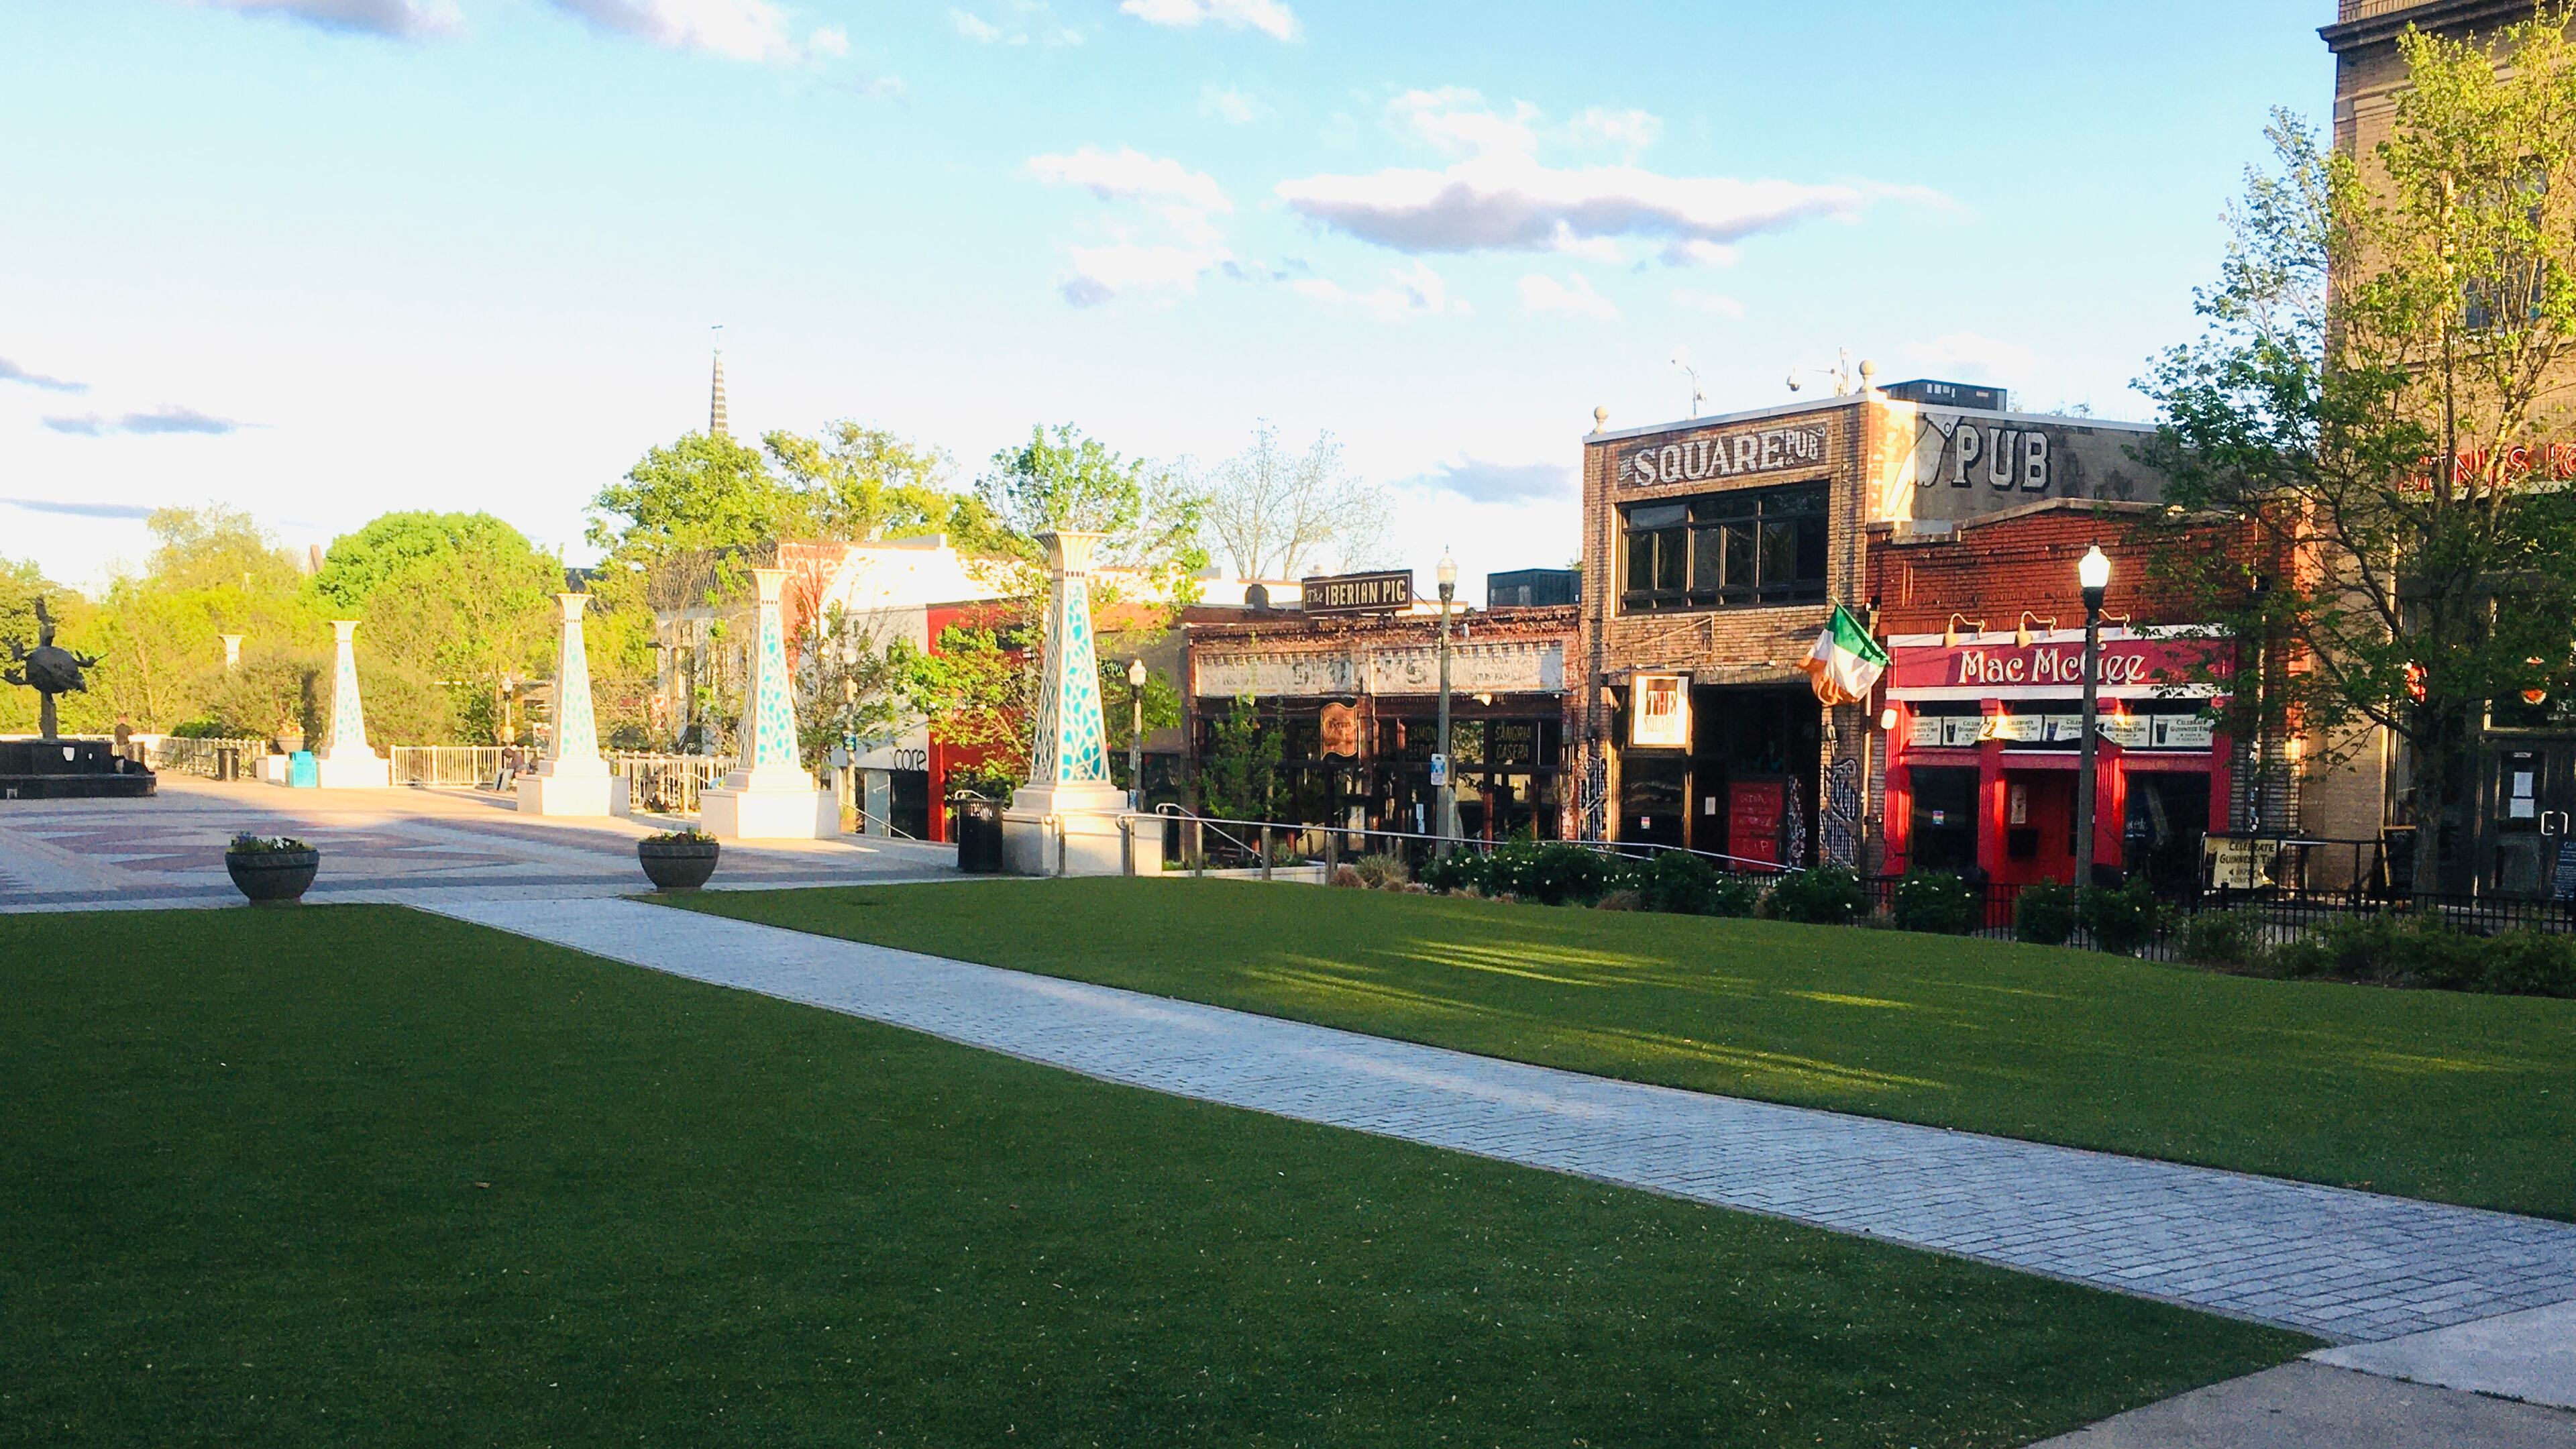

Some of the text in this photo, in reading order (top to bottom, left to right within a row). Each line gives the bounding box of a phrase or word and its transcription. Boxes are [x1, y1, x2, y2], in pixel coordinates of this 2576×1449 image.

[1634, 429, 1784, 486] SQUARE
[1786, 429, 1818, 460] PUB
[1939, 424, 2049, 490] PUB
[1307, 579, 1406, 606] The IBERIAN PIG
[1958, 649, 2025, 684] Mac
[1646, 690, 1677, 716] THE
[894, 749, 926, 771] core
